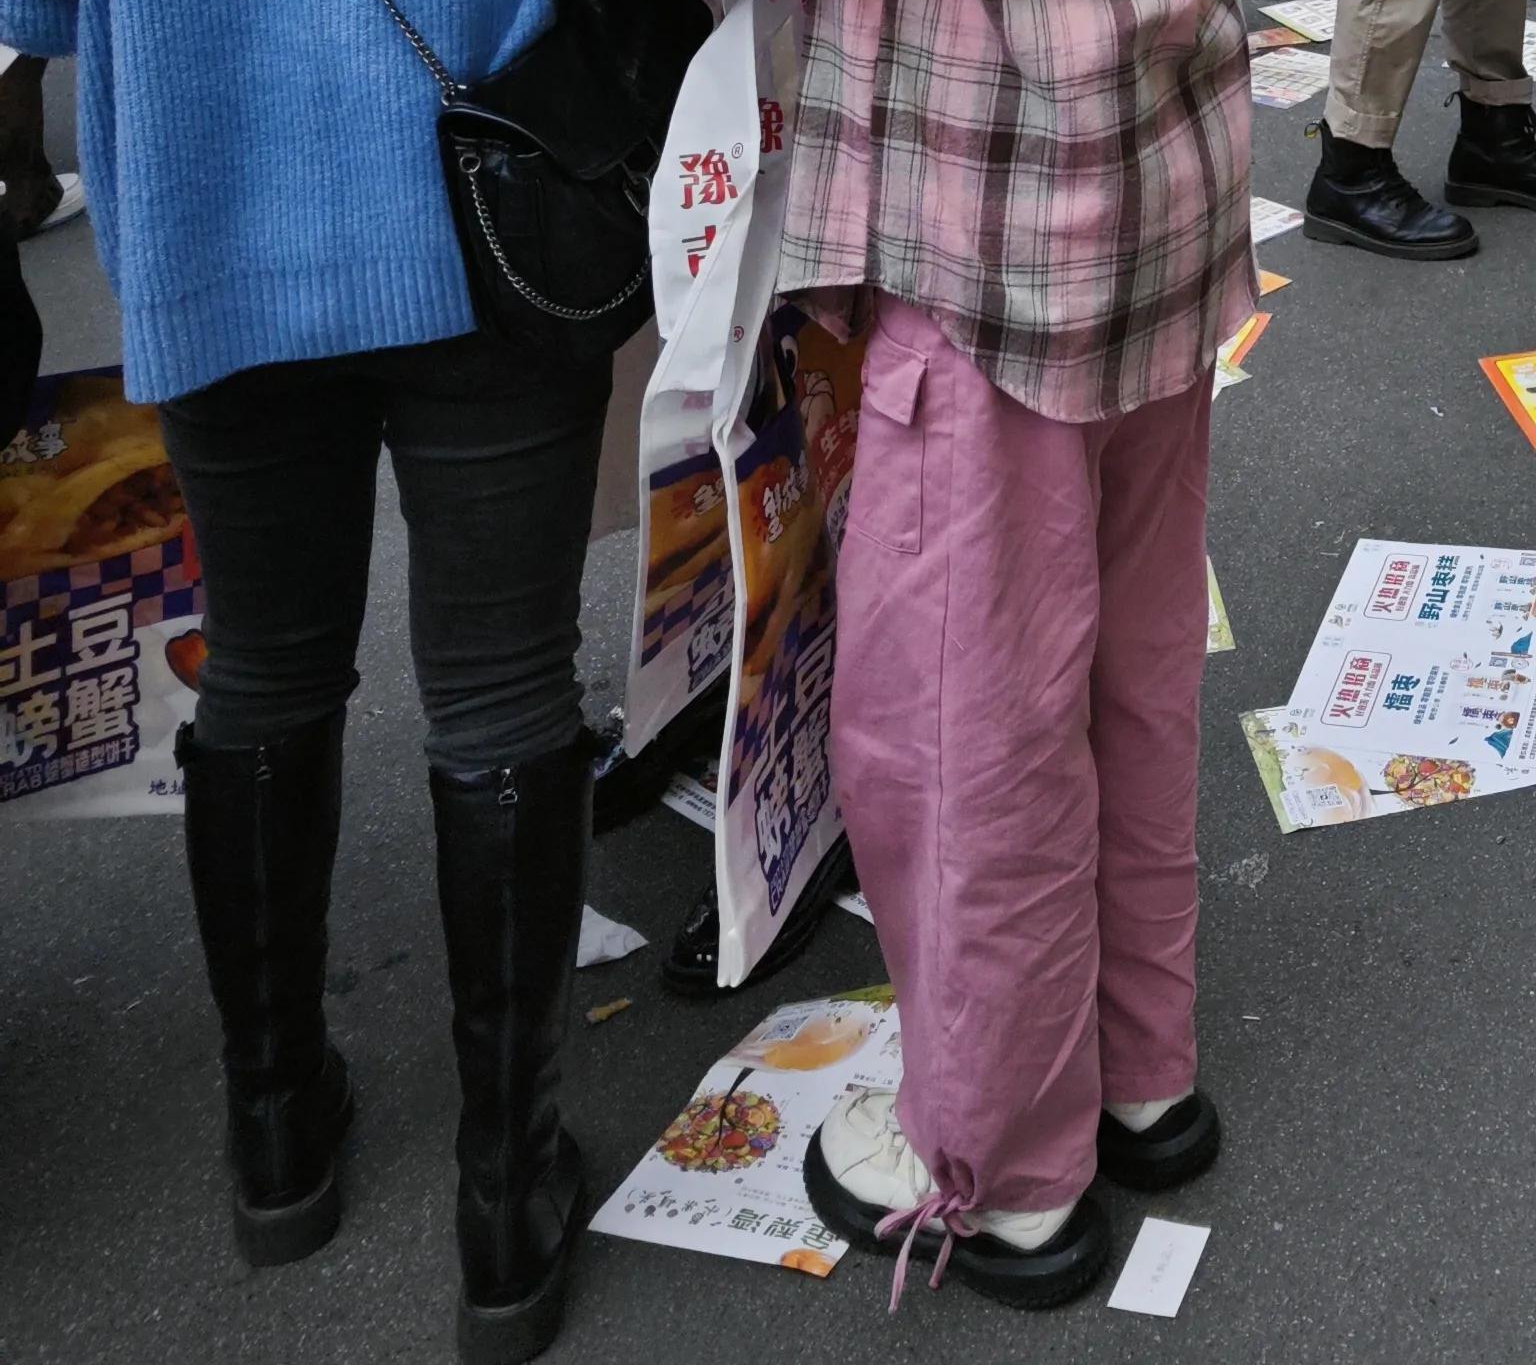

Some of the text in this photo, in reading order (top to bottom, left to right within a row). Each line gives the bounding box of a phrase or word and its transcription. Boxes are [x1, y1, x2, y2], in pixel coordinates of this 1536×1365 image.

[1371, 558, 1412, 615] 火热招商
[1329, 655, 1373, 720] 火热招商
